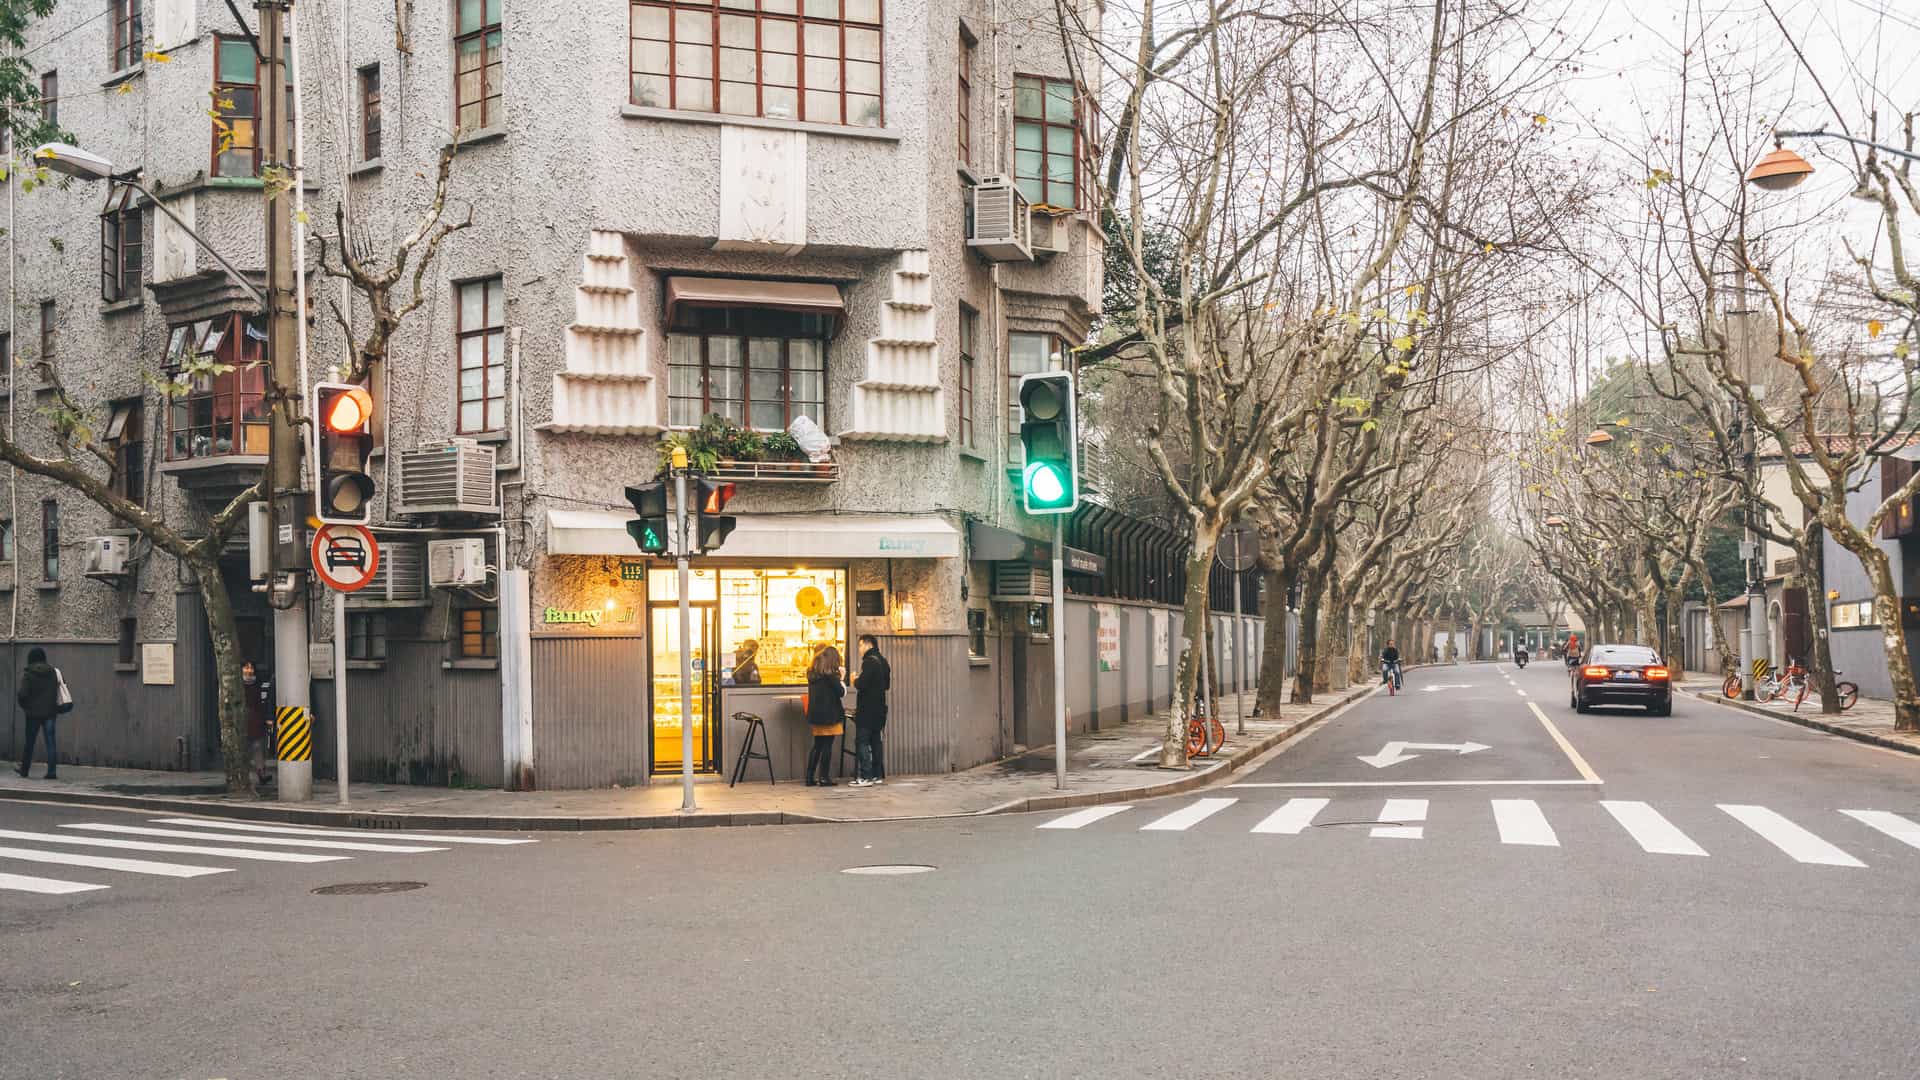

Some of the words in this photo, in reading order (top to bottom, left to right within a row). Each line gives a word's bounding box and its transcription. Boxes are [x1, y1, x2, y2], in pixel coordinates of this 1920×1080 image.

[879, 536, 927, 554] fancy
[623, 565, 641, 576] 115
[544, 606, 602, 627] fancy
